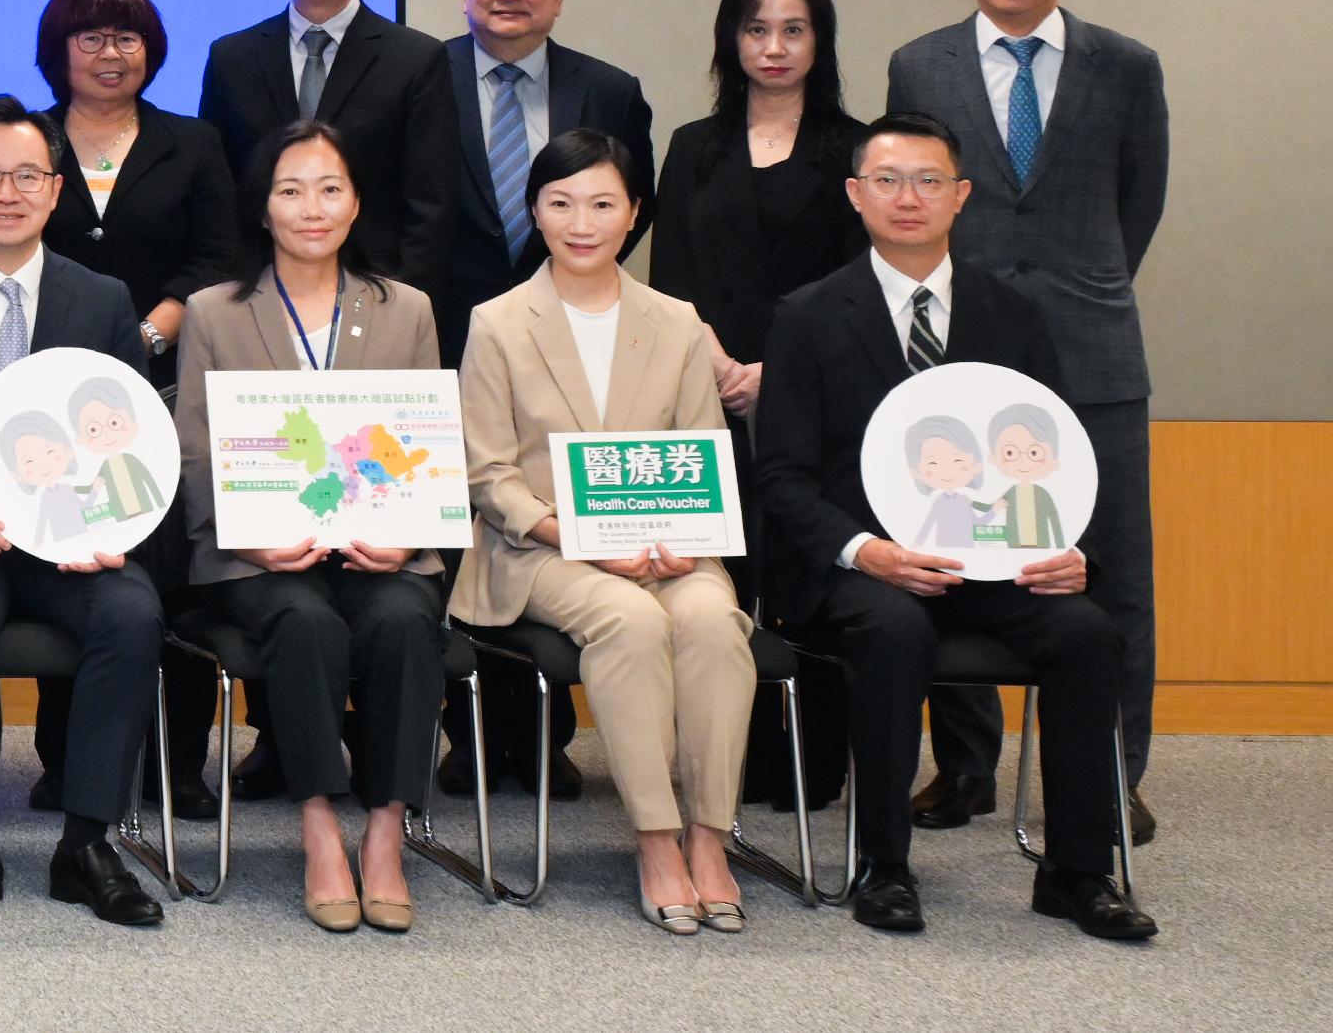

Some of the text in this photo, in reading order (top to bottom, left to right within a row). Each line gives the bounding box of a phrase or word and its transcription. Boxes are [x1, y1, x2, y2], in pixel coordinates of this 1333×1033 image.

[584, 444, 704, 486] 醫療券
[587, 497, 710, 511] Health Care Voucher
